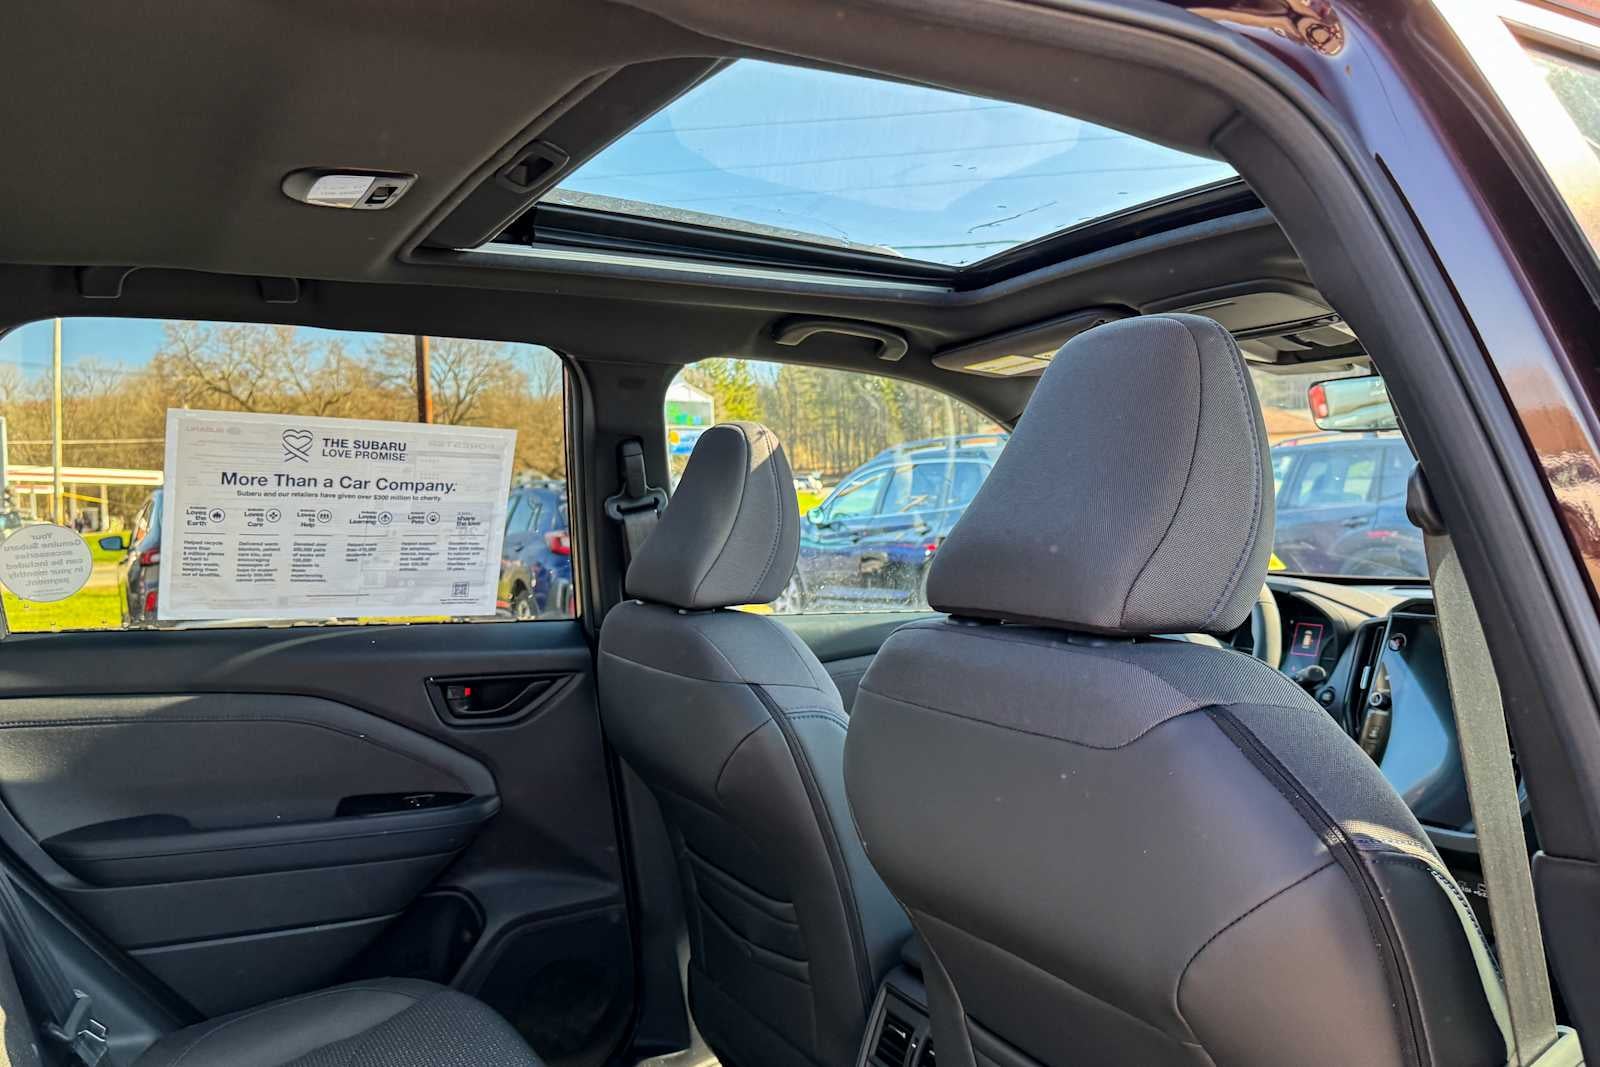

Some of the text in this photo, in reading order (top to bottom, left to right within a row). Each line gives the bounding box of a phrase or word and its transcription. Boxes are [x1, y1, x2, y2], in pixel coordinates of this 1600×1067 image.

[322, 438, 406, 452] THE SUBARU
[322, 450, 406, 462] LOVE PROMISE
[221, 472, 456, 494] More Than a Car Company.
